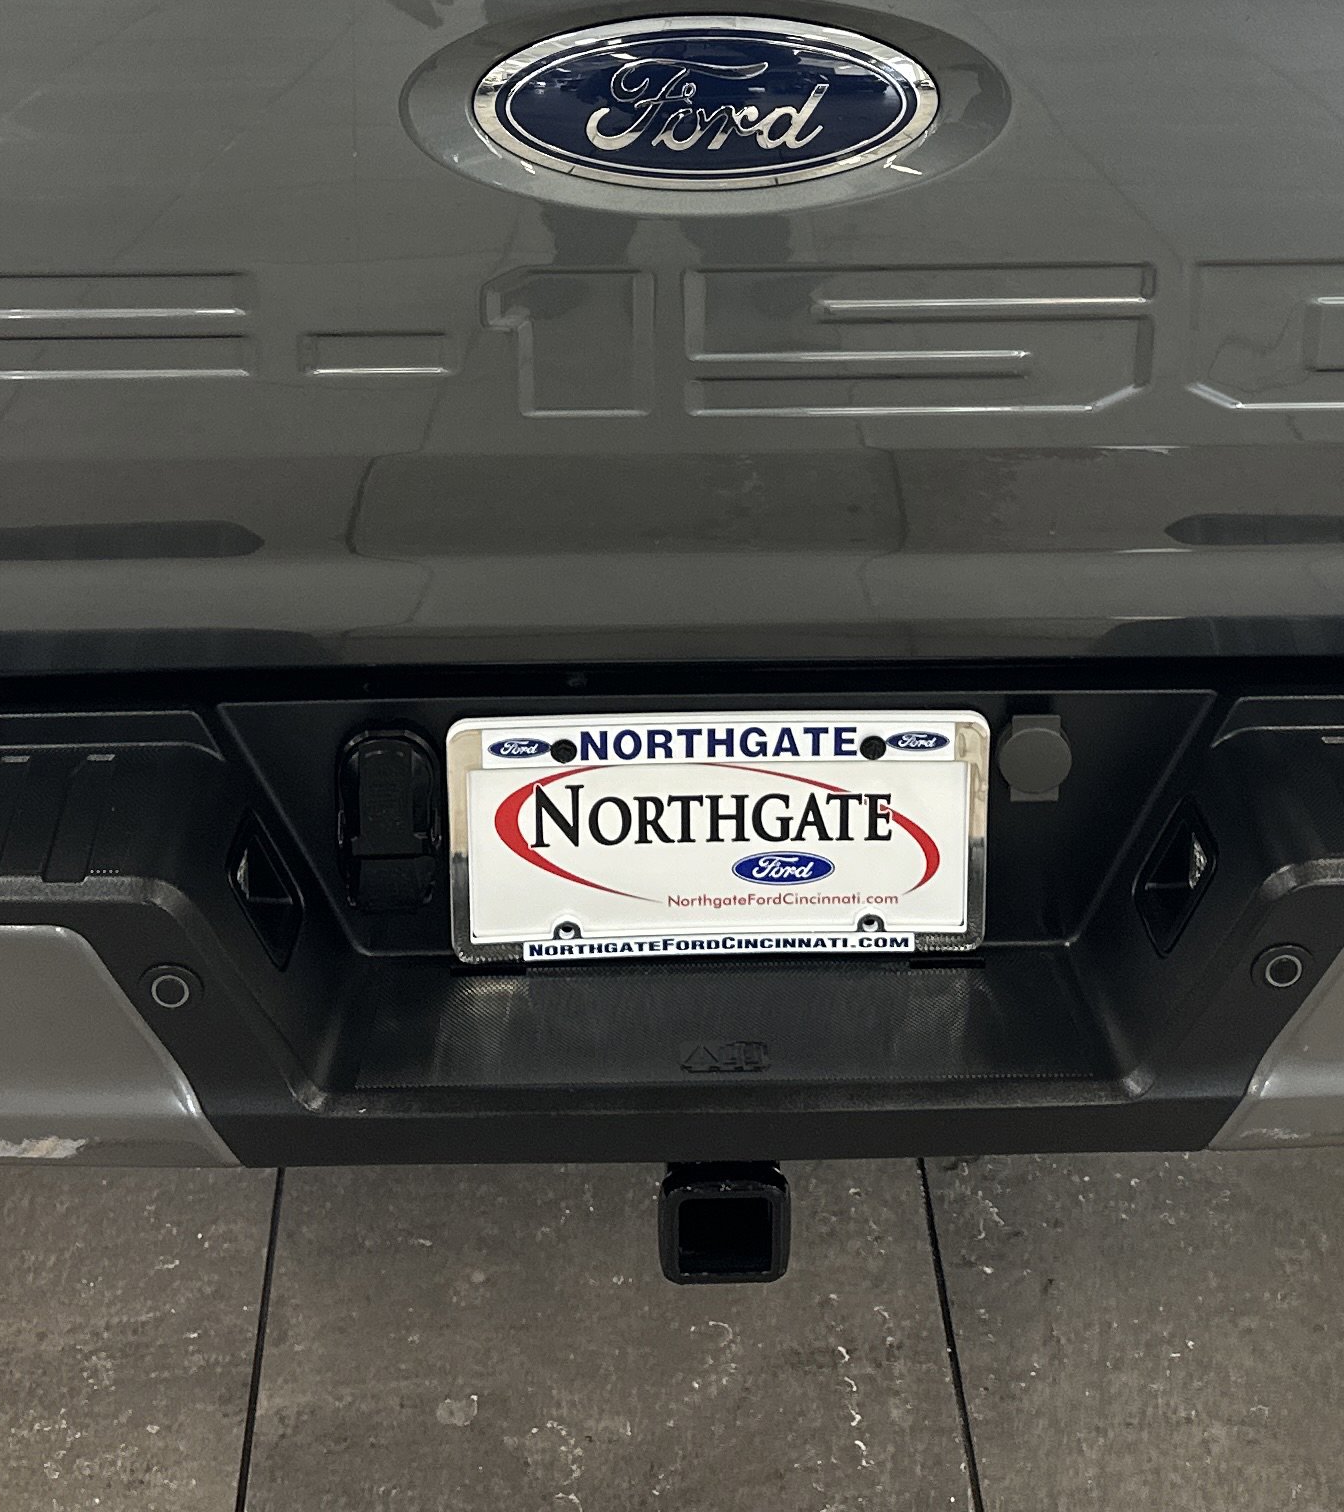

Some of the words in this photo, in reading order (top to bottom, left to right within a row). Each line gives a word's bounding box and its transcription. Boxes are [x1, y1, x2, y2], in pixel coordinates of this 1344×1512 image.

[586, 57, 829, 151] Ford
[500, 740, 537, 755] Ford
[580, 726, 858, 761] NORTHGATE
[898, 734, 937, 748] Ford
[530, 784, 893, 848] NORTHGATE
[751, 854, 813, 879] Ford
[667, 891, 899, 909] NorthgateFordCincinnati.com
